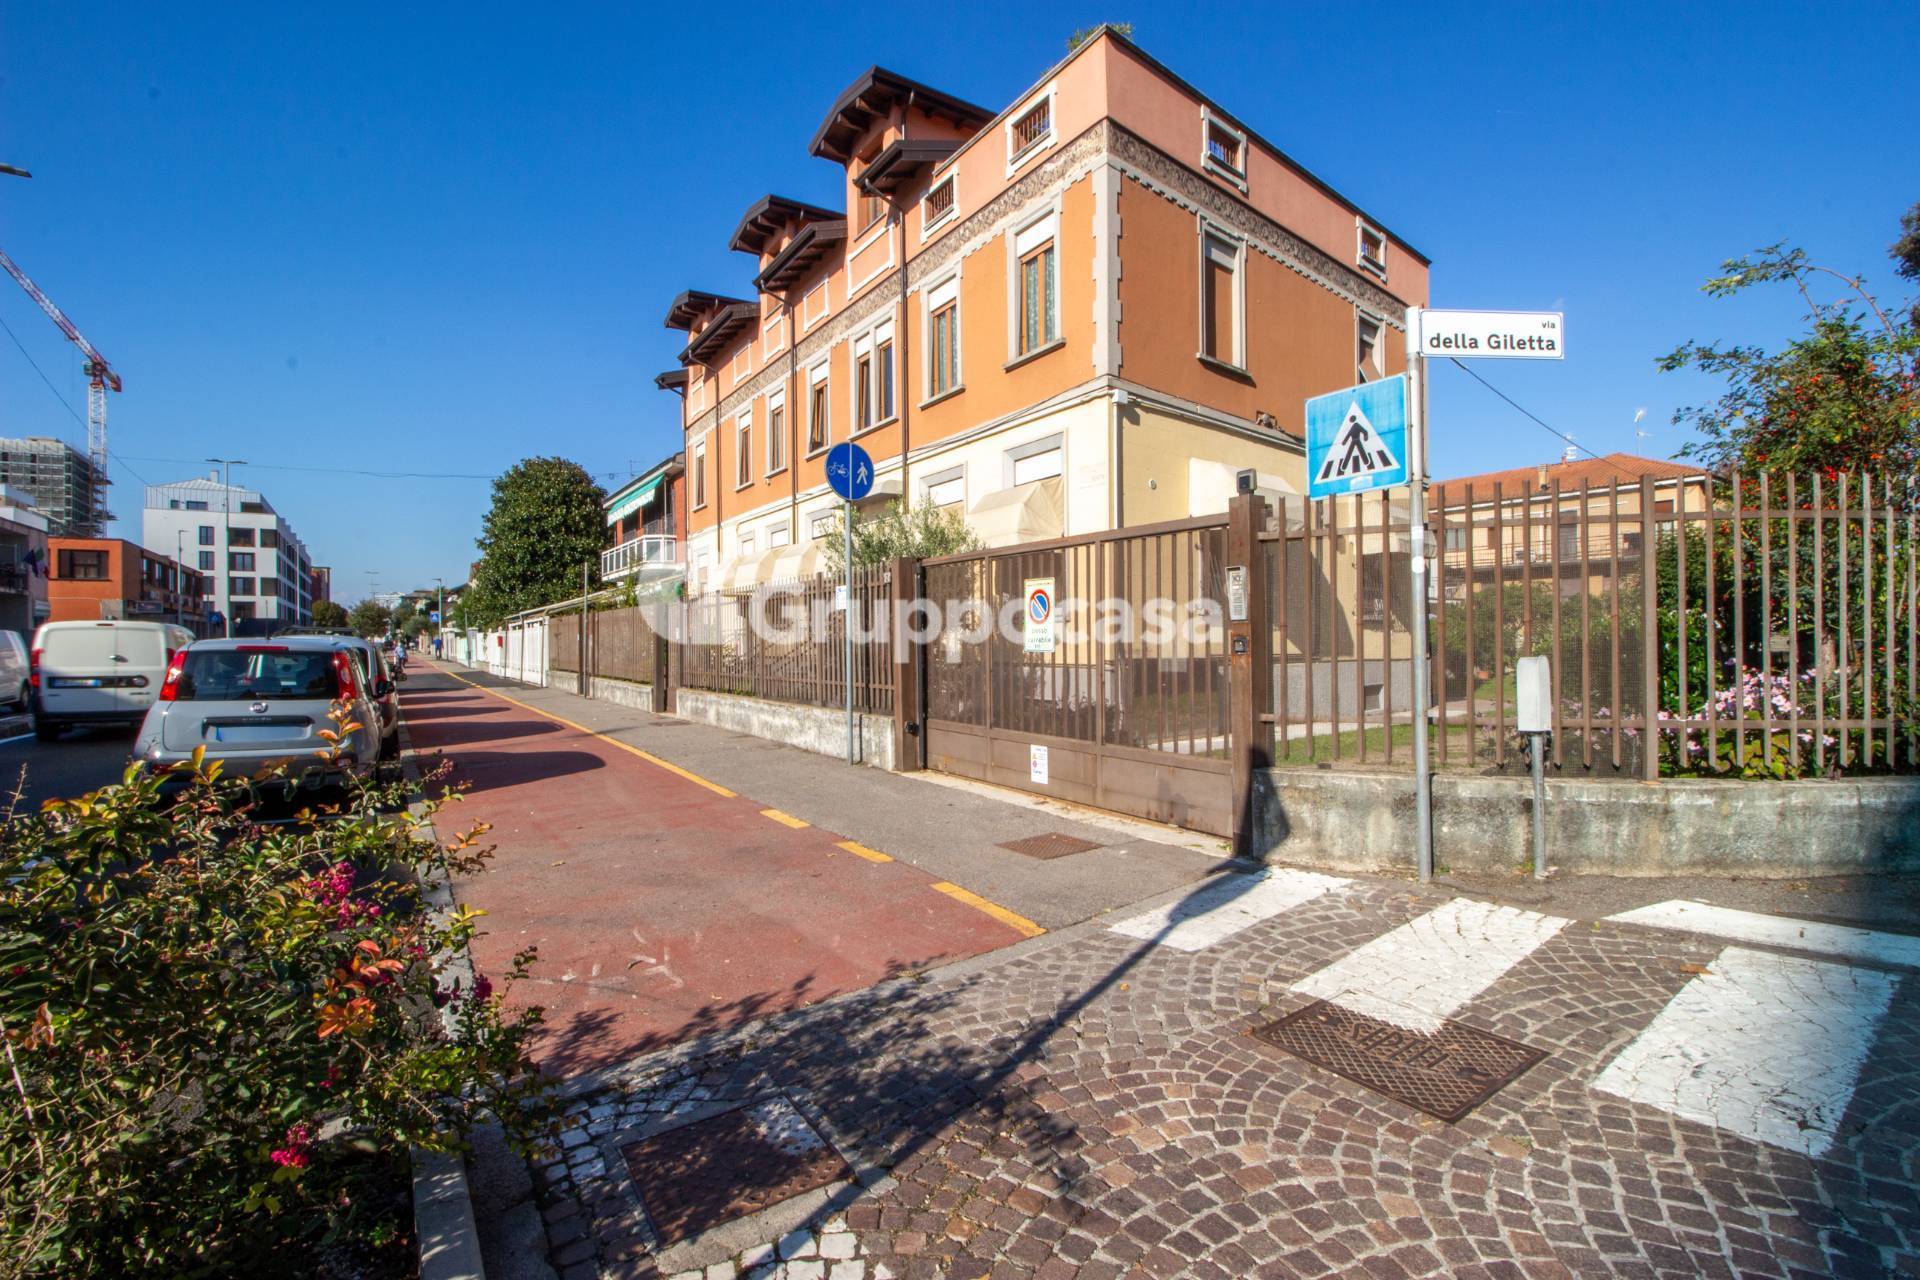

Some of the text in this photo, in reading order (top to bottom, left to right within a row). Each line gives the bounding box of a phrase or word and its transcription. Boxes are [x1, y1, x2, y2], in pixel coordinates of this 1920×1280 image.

[1542, 321, 1556, 329] via
[1429, 333, 1556, 351] della Giletta
